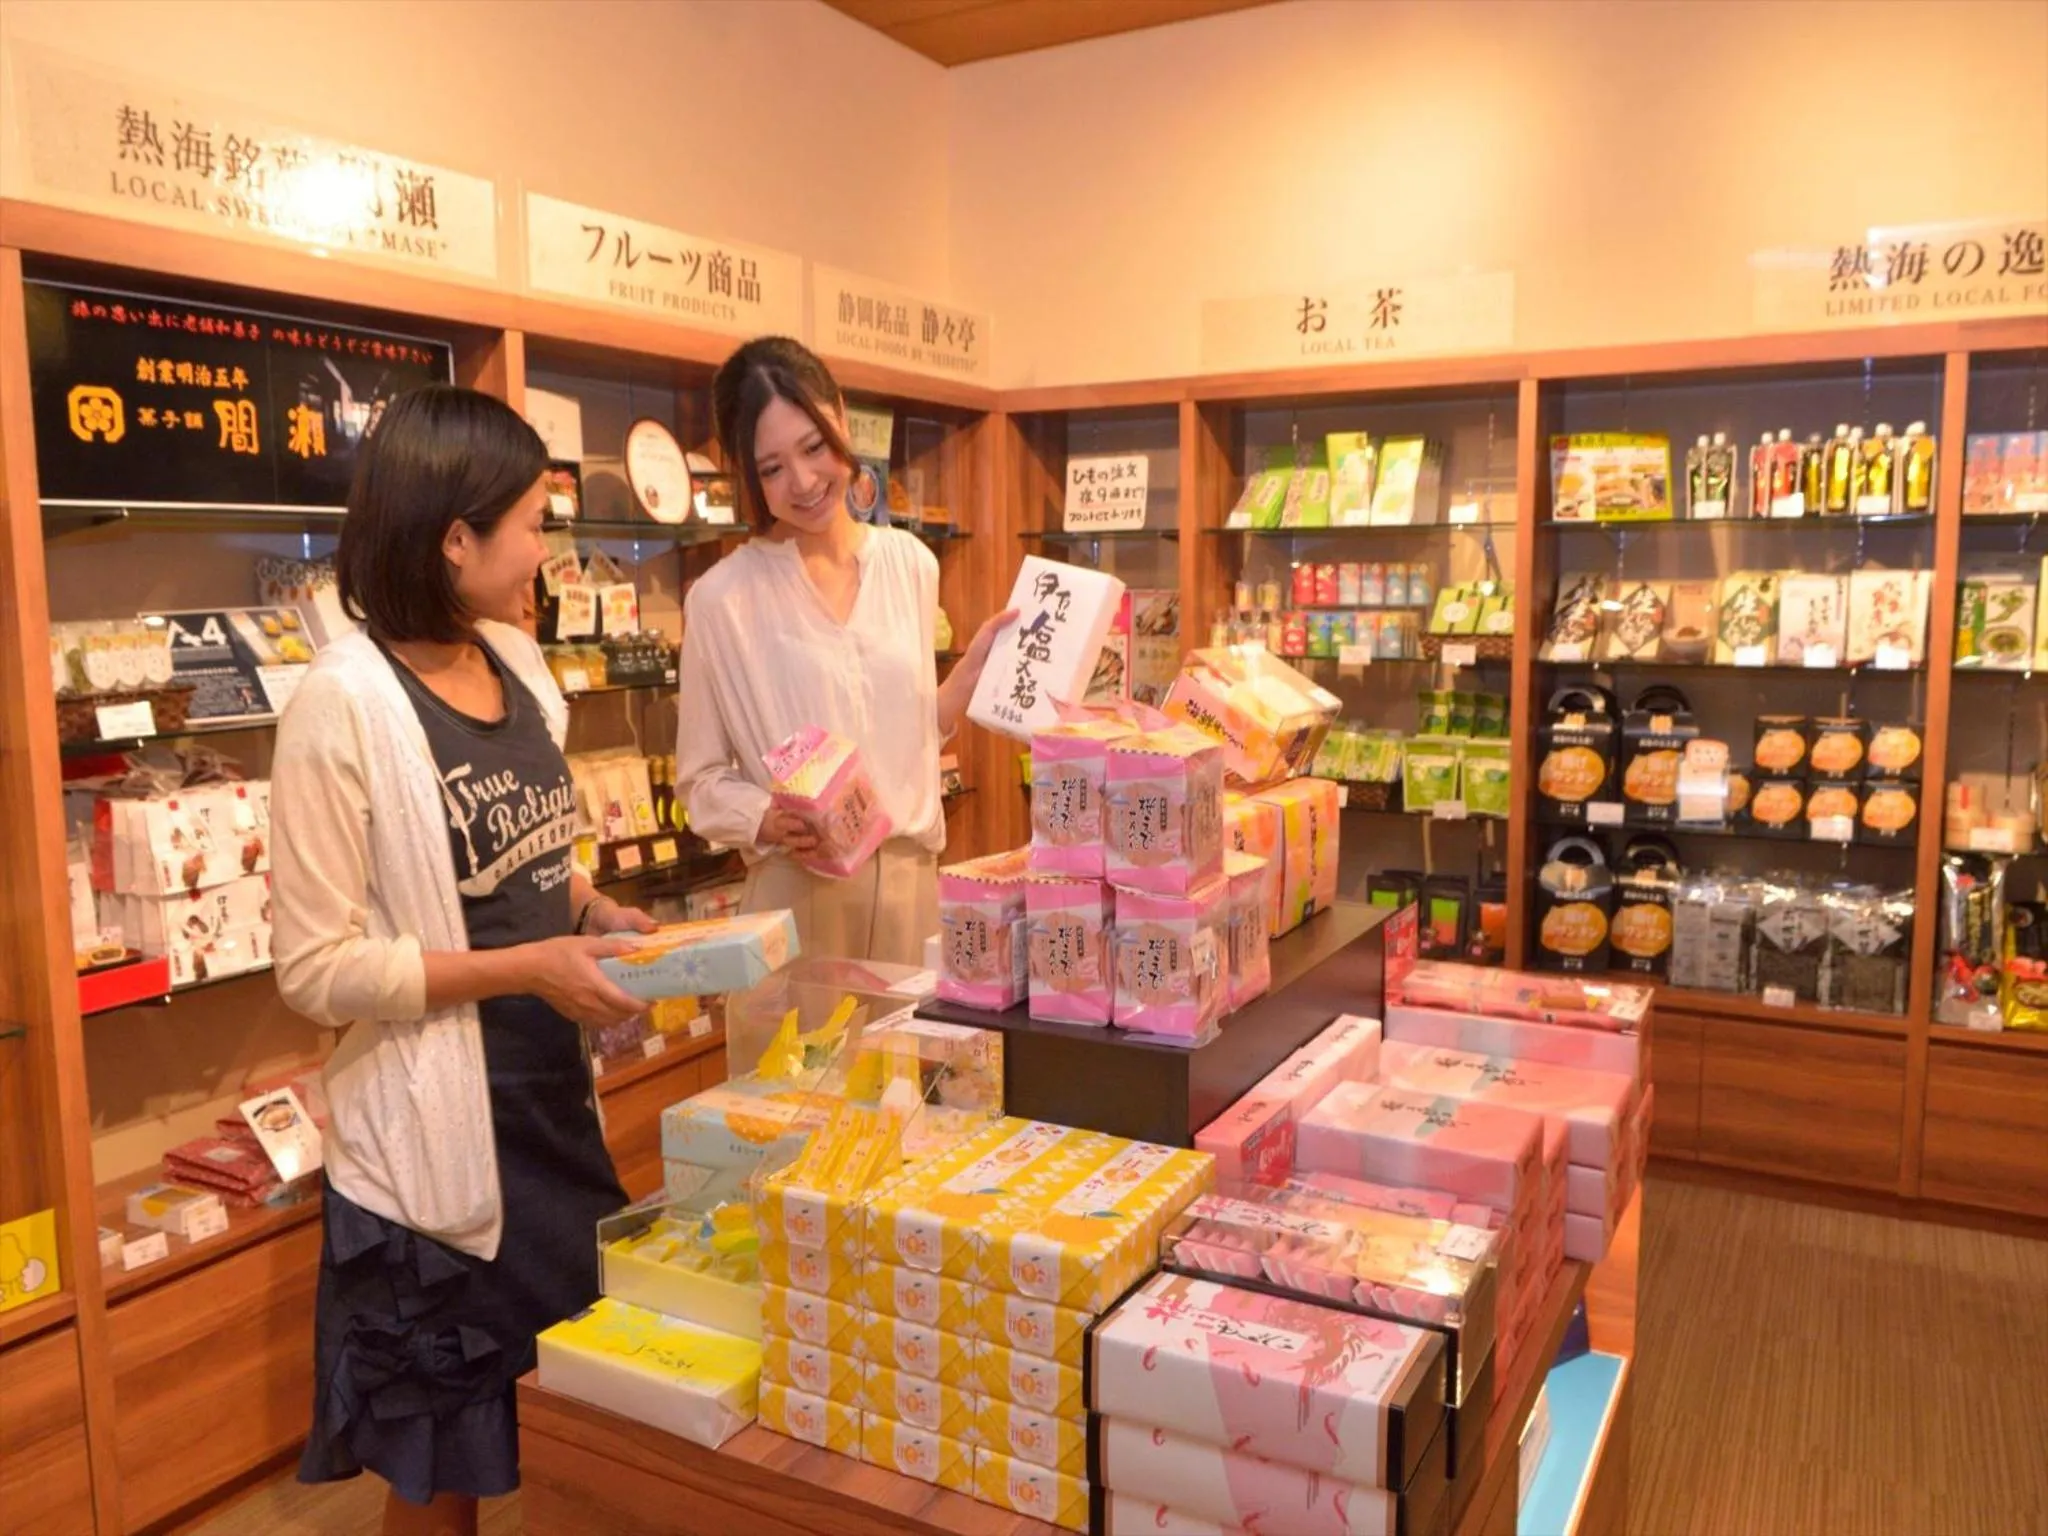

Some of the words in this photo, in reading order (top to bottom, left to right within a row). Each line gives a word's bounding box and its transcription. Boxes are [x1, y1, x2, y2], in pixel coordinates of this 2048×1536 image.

[110, 170, 205, 212] LOCAL
[580, 223, 761, 305] フルーツ商品
[608, 279, 656, 307] FRUIT
[662, 290, 738, 321] PRODUCTS
[837, 288, 910, 338] 静岡銘品
[921, 305, 976, 353] 静々亭
[1296, 287, 1403, 335] お茶
[1825, 293, 1921, 317] LIMITED
[1932, 287, 2011, 309] LOCAL
[1301, 337, 1358, 356] LOCAL
[1365, 335, 1397, 352] TEA
[135, 355, 250, 392] 創業明治五年
[487, 775, 575, 852] Religi
[493, 822, 574, 880] CALIFOR
